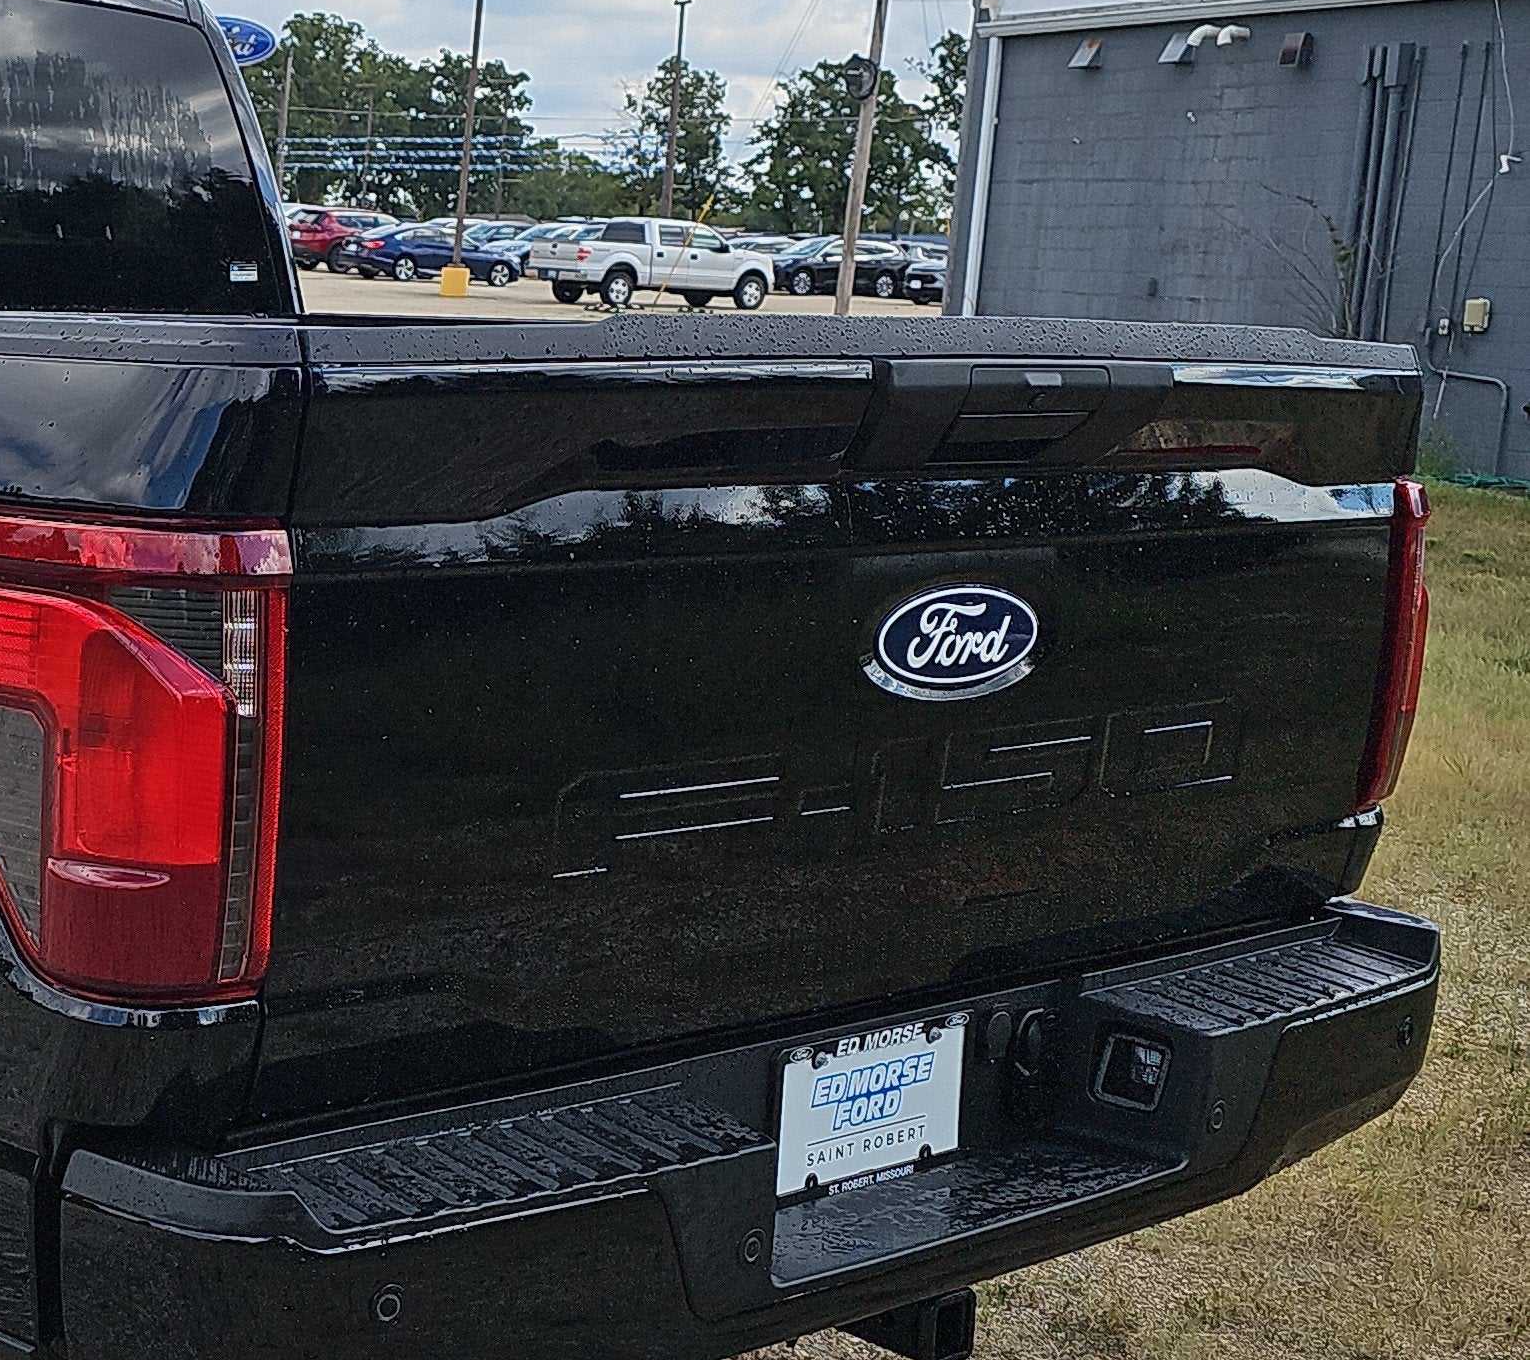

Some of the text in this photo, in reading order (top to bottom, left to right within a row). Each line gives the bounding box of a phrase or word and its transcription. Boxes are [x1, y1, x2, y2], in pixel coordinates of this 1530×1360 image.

[907, 602, 1013, 669] Ford
[836, 1022, 925, 1058] ED MORSE
[832, 1088, 902, 1132] FORD
[806, 1125, 926, 1167] SAINT ROBERT
[876, 1164, 914, 1184] MISSOURI
